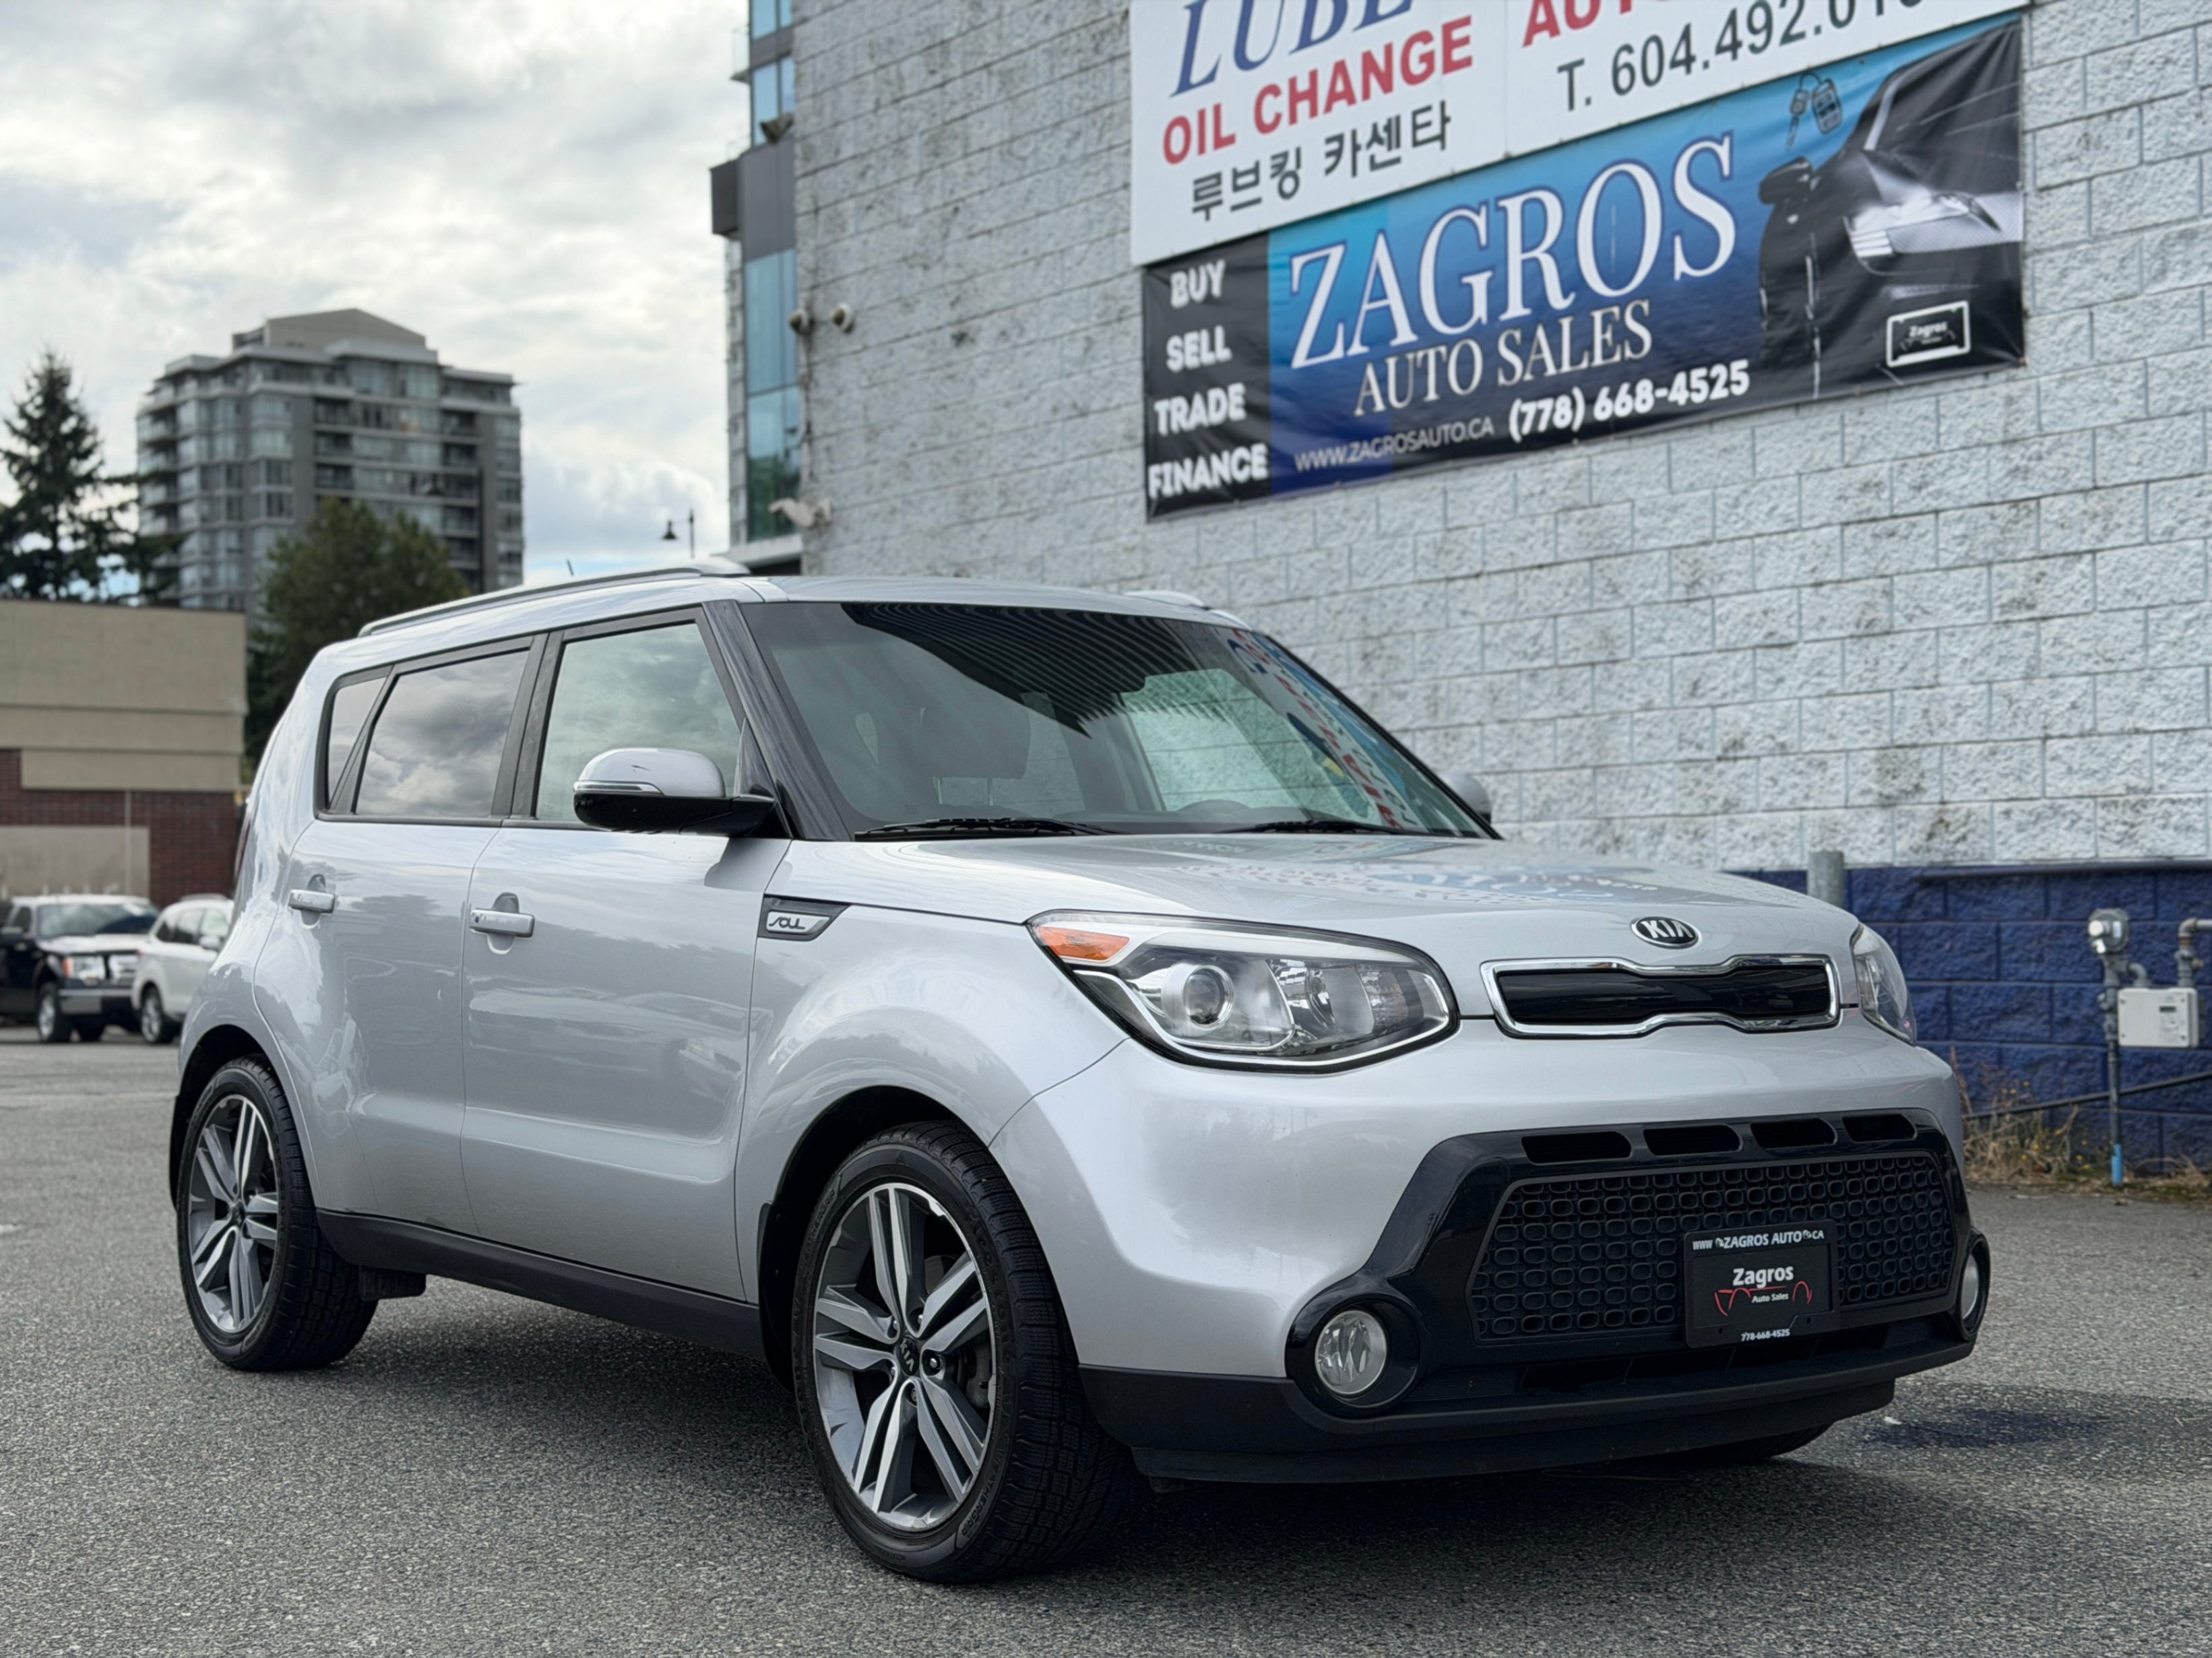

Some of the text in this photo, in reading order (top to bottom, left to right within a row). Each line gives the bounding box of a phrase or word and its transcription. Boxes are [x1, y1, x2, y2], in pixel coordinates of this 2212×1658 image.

[1521, 0, 1669, 48] AU
[1556, 0, 1922, 111] T. 604.492.0
[1162, 15, 1473, 165] OIL CHANGE
[1192, 100, 1451, 222] 루브킹 카센타
[1290, 133, 1736, 369] ZAGROS
[1170, 259, 1226, 308] BUY
[1166, 325, 1232, 372] SELL
[1354, 298, 1653, 418] AUTO SALES
[1153, 381, 1246, 437] TRADE
[1509, 358, 1750, 444] (778) 668-4525
[1294, 415, 1494, 473] WWW.ZAGROSAUTO.CA
[1147, 443, 1269, 499] FINANCE
[1640, 920, 1694, 938] KIA
[1723, 1233, 1769, 1249] ZAGROS
[1771, 1230, 1802, 1245] AUTO
[1732, 1266, 1794, 1289] Zagros
[1752, 1292, 1789, 1304] Auto Sales
[899, 1337, 915, 1372] KIA
[1741, 1328, 1790, 1342] 778-668-4525
